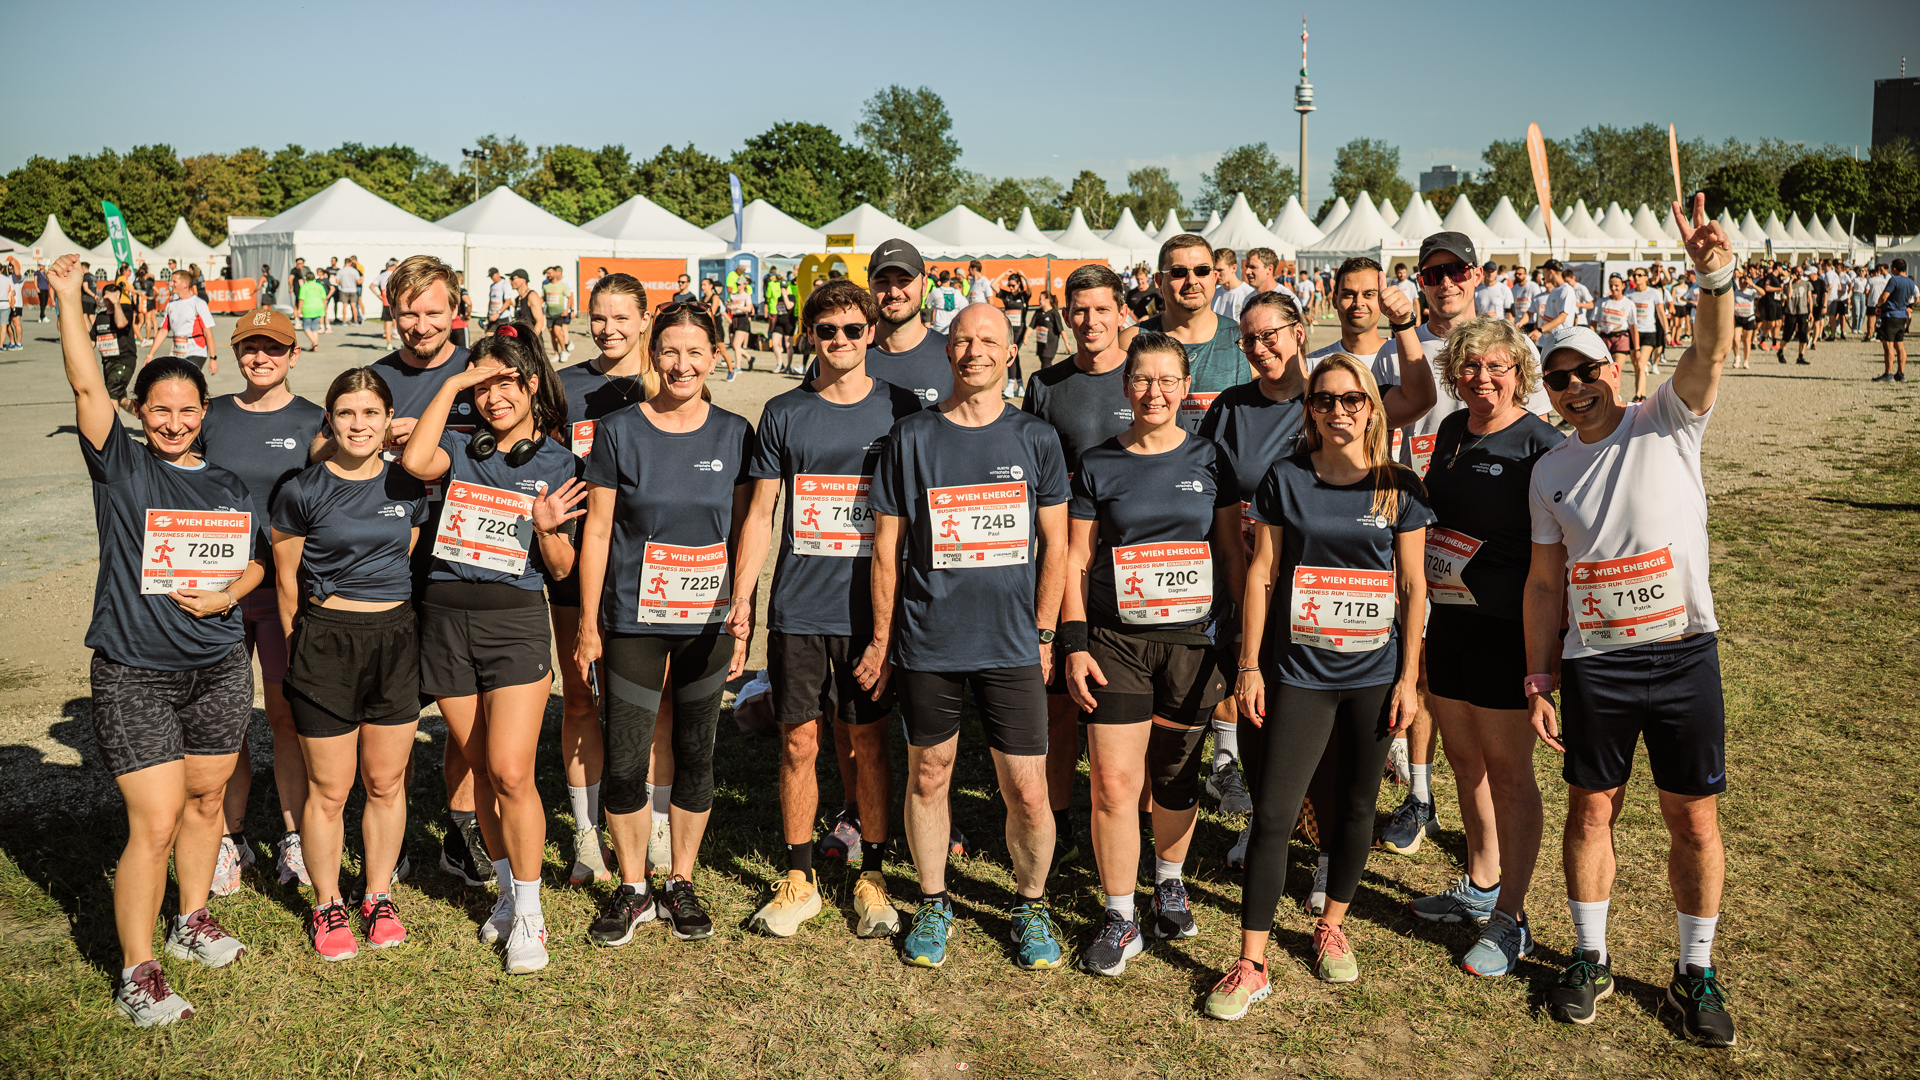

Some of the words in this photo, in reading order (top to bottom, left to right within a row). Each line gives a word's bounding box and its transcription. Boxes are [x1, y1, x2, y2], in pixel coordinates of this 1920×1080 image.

[206, 288, 251, 302] NERGIE
[471, 492, 494, 502] WIEN
[956, 493, 980, 501] WIEN
[450, 502, 476, 511] BUSINESS
[833, 507, 874, 520] 718A
[176, 518, 202, 526] WIEN
[204, 519, 244, 528] ENERGIE
[478, 517, 518, 537] 722C
[971, 514, 1015, 530] 724B
[188, 543, 234, 557] 720B
[1445, 536, 1474, 552] ENERGIE
[671, 553, 694, 561] WIEN
[696, 551, 724, 562] ENERGIE
[1140, 549, 1164, 557] WIEN
[1167, 548, 1204, 556] ENERGIE
[1427, 554, 1451, 576] 720A
[1593, 566, 1621, 577] WIEN
[1623, 556, 1666, 573] ENERGIE
[680, 576, 720, 590] 722B
[1155, 570, 1198, 586] 720C
[1321, 576, 1346, 584] WIEN
[1349, 578, 1388, 586] ENERGIE
[1613, 584, 1665, 606] 718C
[1333, 602, 1379, 617] 717B
